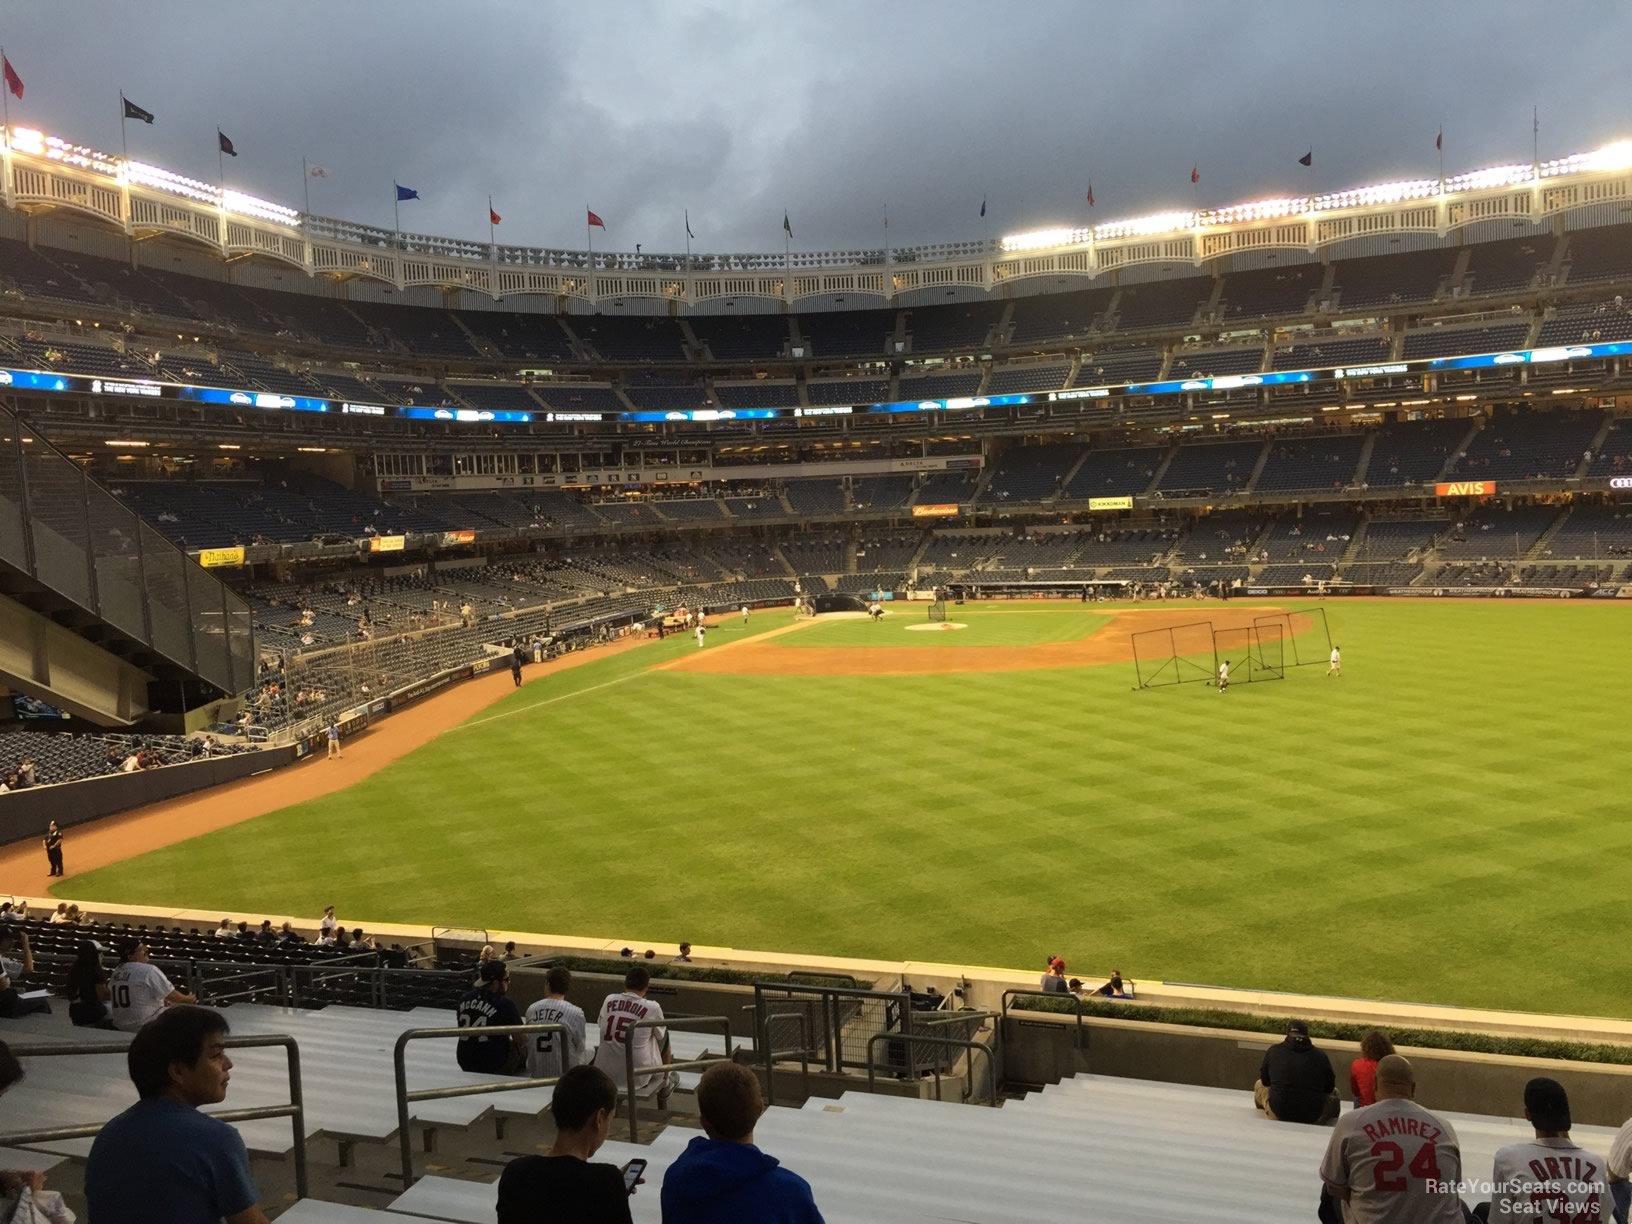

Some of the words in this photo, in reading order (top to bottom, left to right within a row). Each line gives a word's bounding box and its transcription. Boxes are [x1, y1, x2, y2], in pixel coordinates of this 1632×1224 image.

[1448, 482, 1484, 495] AVIS
[112, 985, 130, 1008] 10
[533, 1008, 563, 1022] JETER
[607, 1000, 648, 1019] PEDROIA
[1363, 1117, 1441, 1144] RAMIREZ
[1371, 1141, 1441, 1192] 24
[1529, 1156, 1597, 1183] ORTIZ
